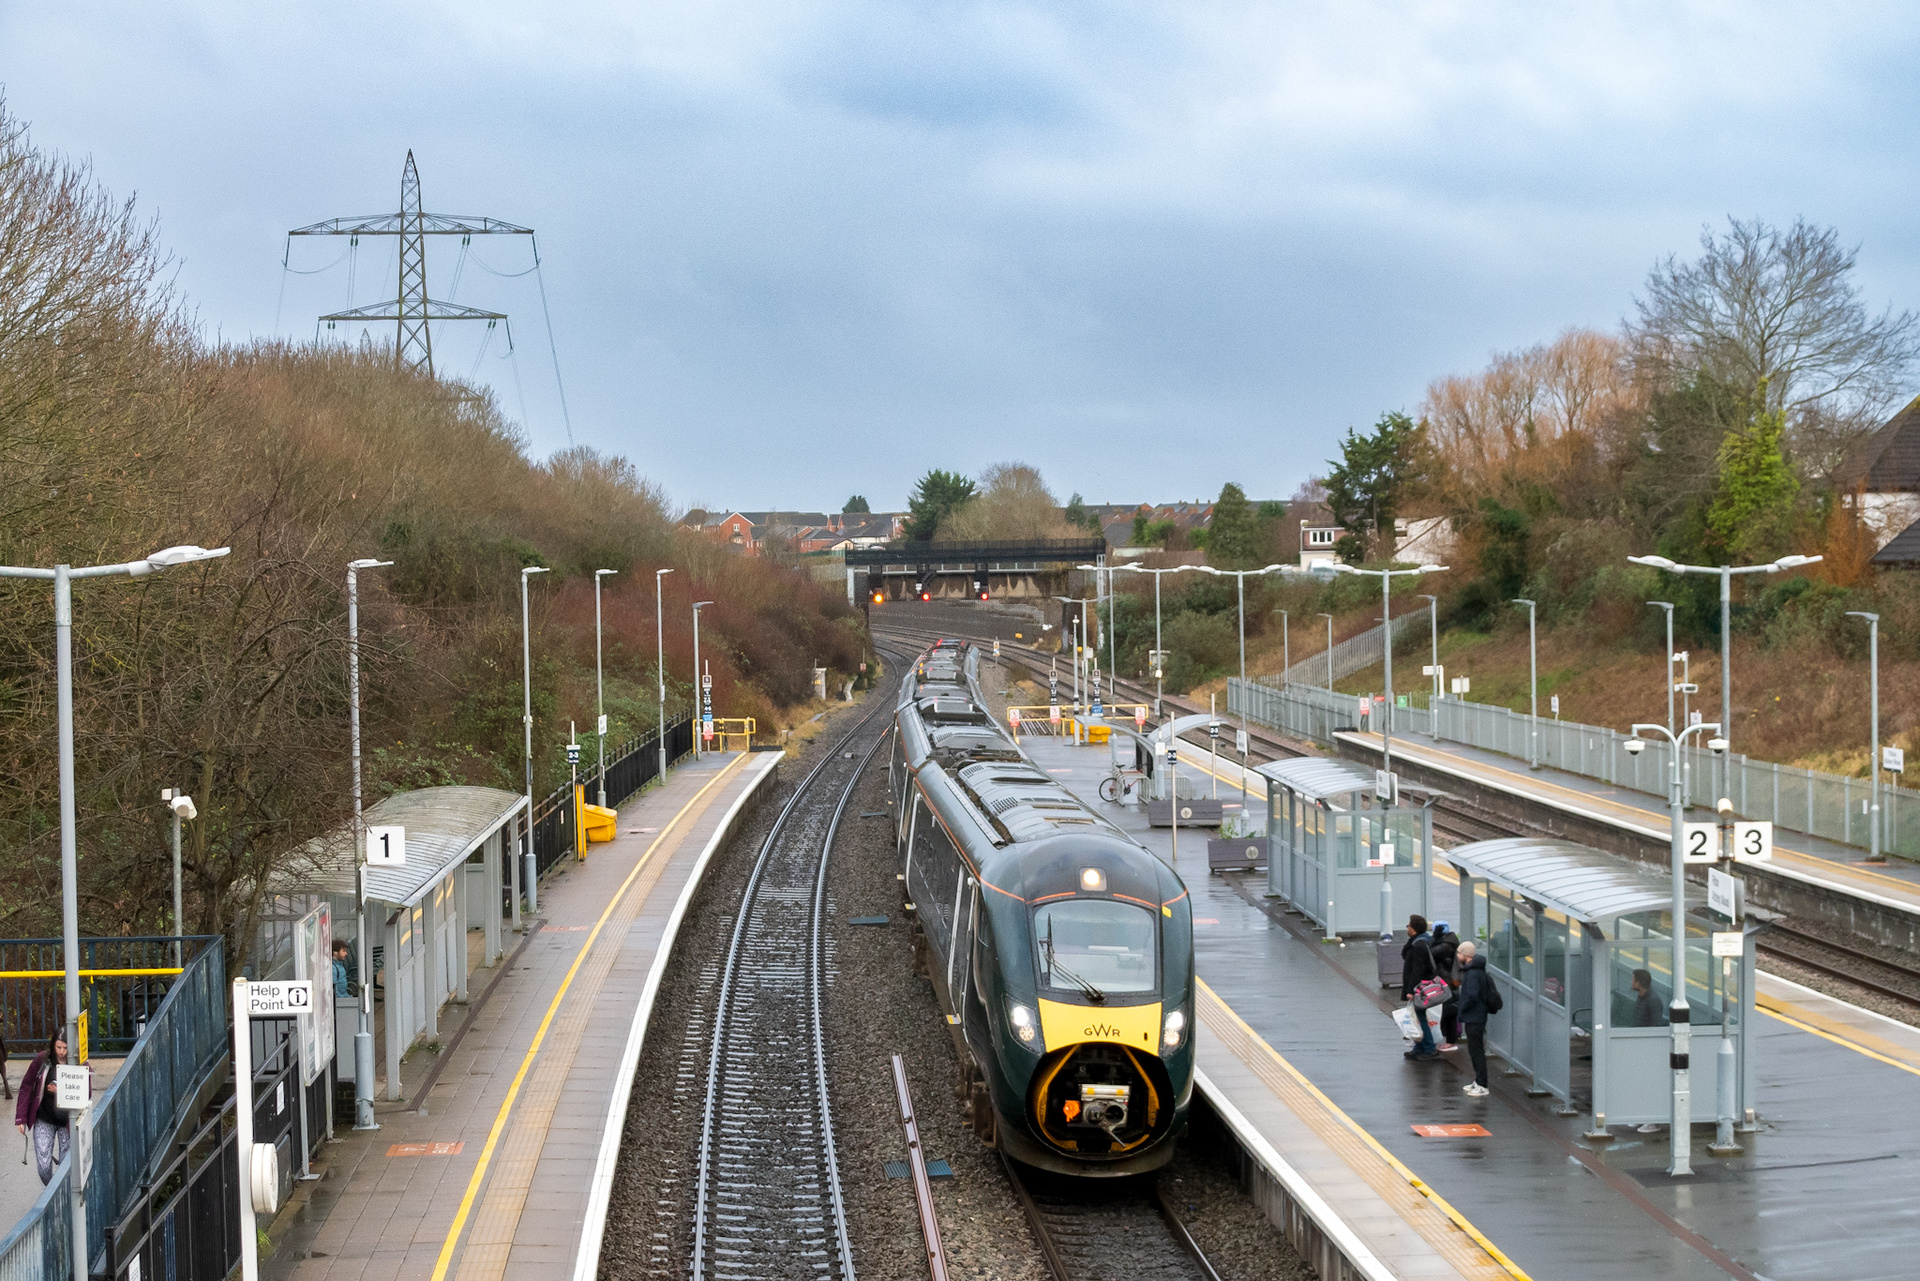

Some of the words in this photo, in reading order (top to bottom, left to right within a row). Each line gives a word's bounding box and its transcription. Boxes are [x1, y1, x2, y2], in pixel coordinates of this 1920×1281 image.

[380, 833, 389, 858] 1
[1689, 830, 1707, 856] 2
[1744, 829, 1762, 855] 3
[251, 985, 280, 998] Help
[251, 999, 284, 1010] Point
[1084, 1022, 1120, 1038] GWR
[61, 1072, 84, 1080] Please
